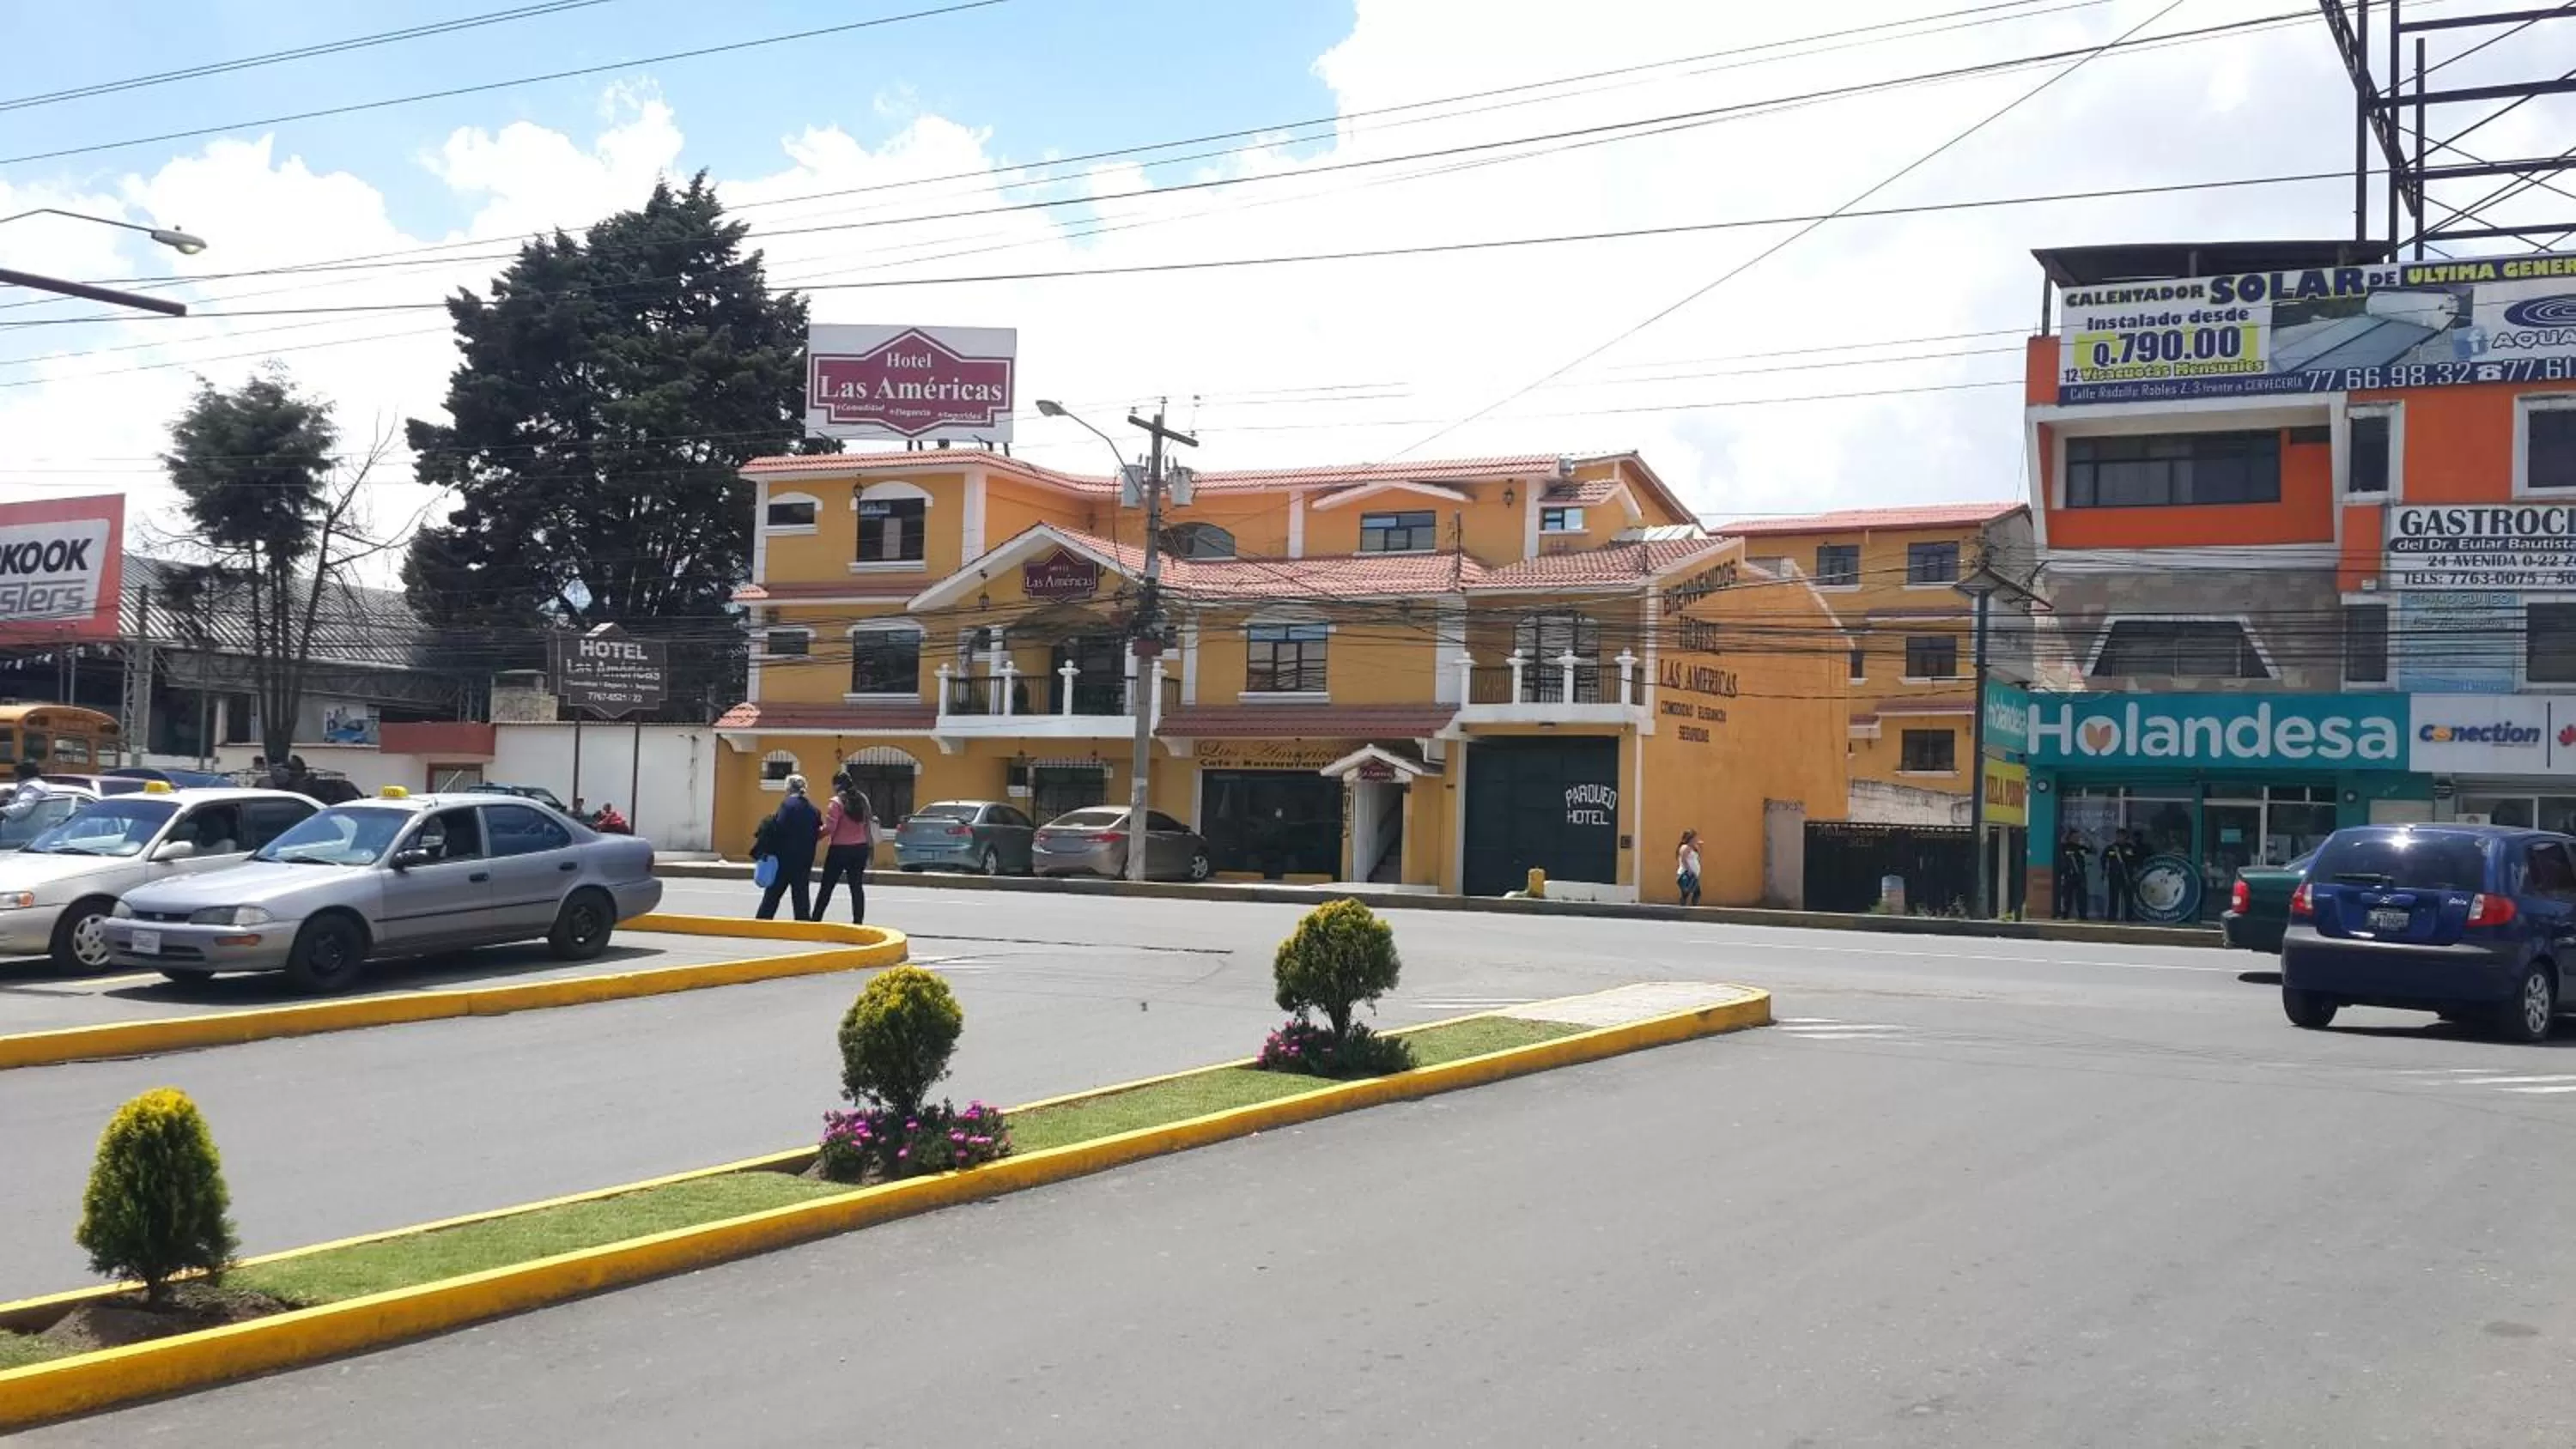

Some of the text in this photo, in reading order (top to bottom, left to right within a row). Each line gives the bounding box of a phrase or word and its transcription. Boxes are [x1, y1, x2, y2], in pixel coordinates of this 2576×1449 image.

[2065, 284, 2204, 306] CALENTADOR
[2208, 267, 2368, 305] SOLAR
[2369, 270, 2397, 286] DE
[2407, 263, 2496, 284] ULTIMA
[2087, 307, 2250, 330] Instalado desde
[2093, 325, 2241, 367] Q.790.00
[886, 352, 933, 368] Hotel
[2064, 367, 2078, 382] 12
[2173, 359, 2265, 377] Mensuales
[819, 375, 1002, 400] Las Américas
[2306, 361, 2471, 391] 77.66.98.32
[2070, 387, 2096, 400] Calle
[2397, 538, 2423, 550] del
[2428, 538, 2454, 550] Dr.
[2458, 537, 2503, 549] Eular
[0, 537, 93, 576] KOOK
[2427, 555, 2447, 567] 24
[2451, 555, 2518, 567] AVENIDA
[2404, 573, 2444, 585] TELS:
[580, 640, 648, 660] HOTEL
[1660, 658, 1681, 690] LAS
[2027, 701, 2398, 759] Holandesa
[1565, 784, 1617, 810] PARQUEO
[1566, 809, 1611, 825] HOTEL
